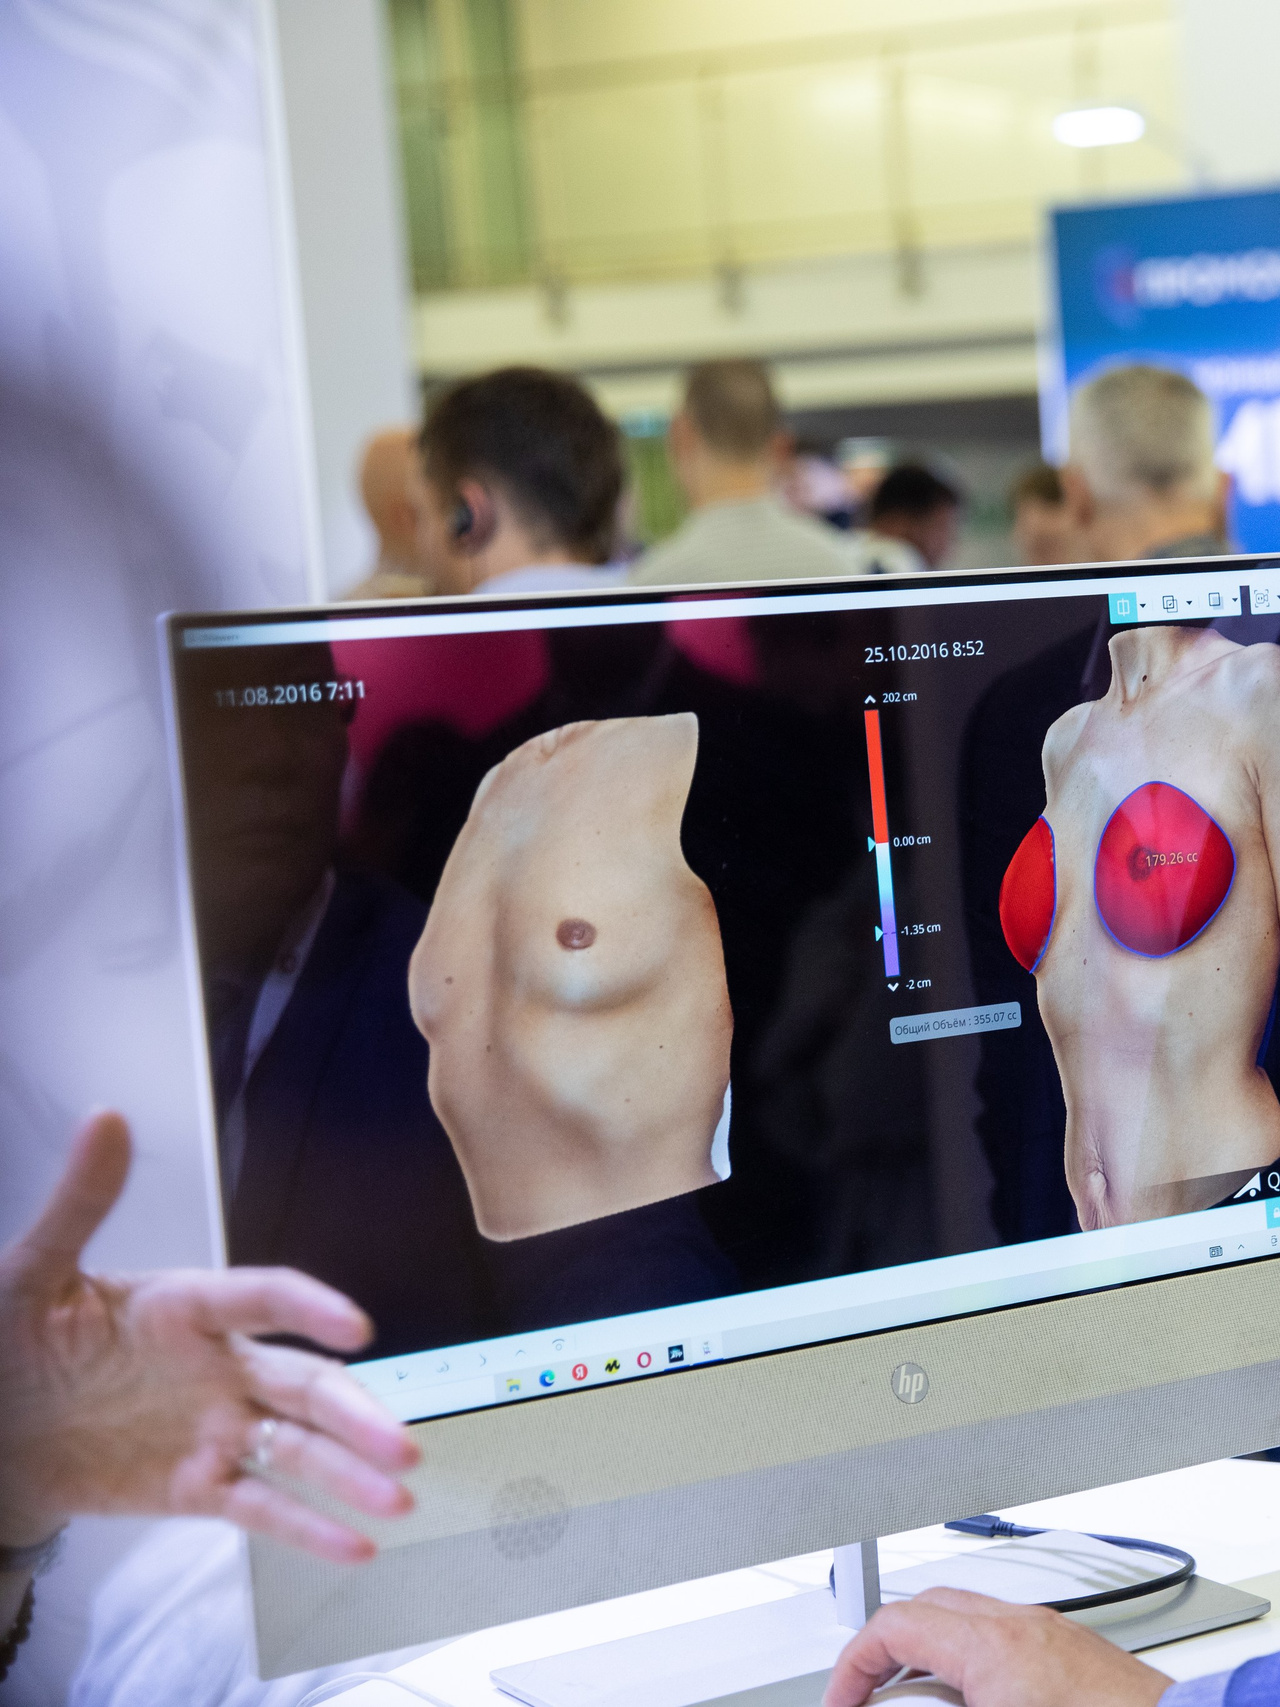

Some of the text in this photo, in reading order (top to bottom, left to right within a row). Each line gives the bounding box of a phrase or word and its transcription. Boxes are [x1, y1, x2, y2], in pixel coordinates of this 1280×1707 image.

[864, 640, 985, 663] 25.10.2016 8:52
[216, 681, 366, 707] 11.08.2016 7:11
[882, 692, 918, 703] 202 cm
[893, 835, 931, 847] 0.00 cm
[1146, 852, 1198, 867] 179.26 cc
[901, 924, 941, 936] -1.35 cm
[905, 979, 932, 990] -2 cm
[894, 1023, 931, 1036] Общий
[932, 1018, 966, 1031] Объём
[973, 1012, 1005, 1025] 355.07
[898, 1364, 924, 1403] hp
